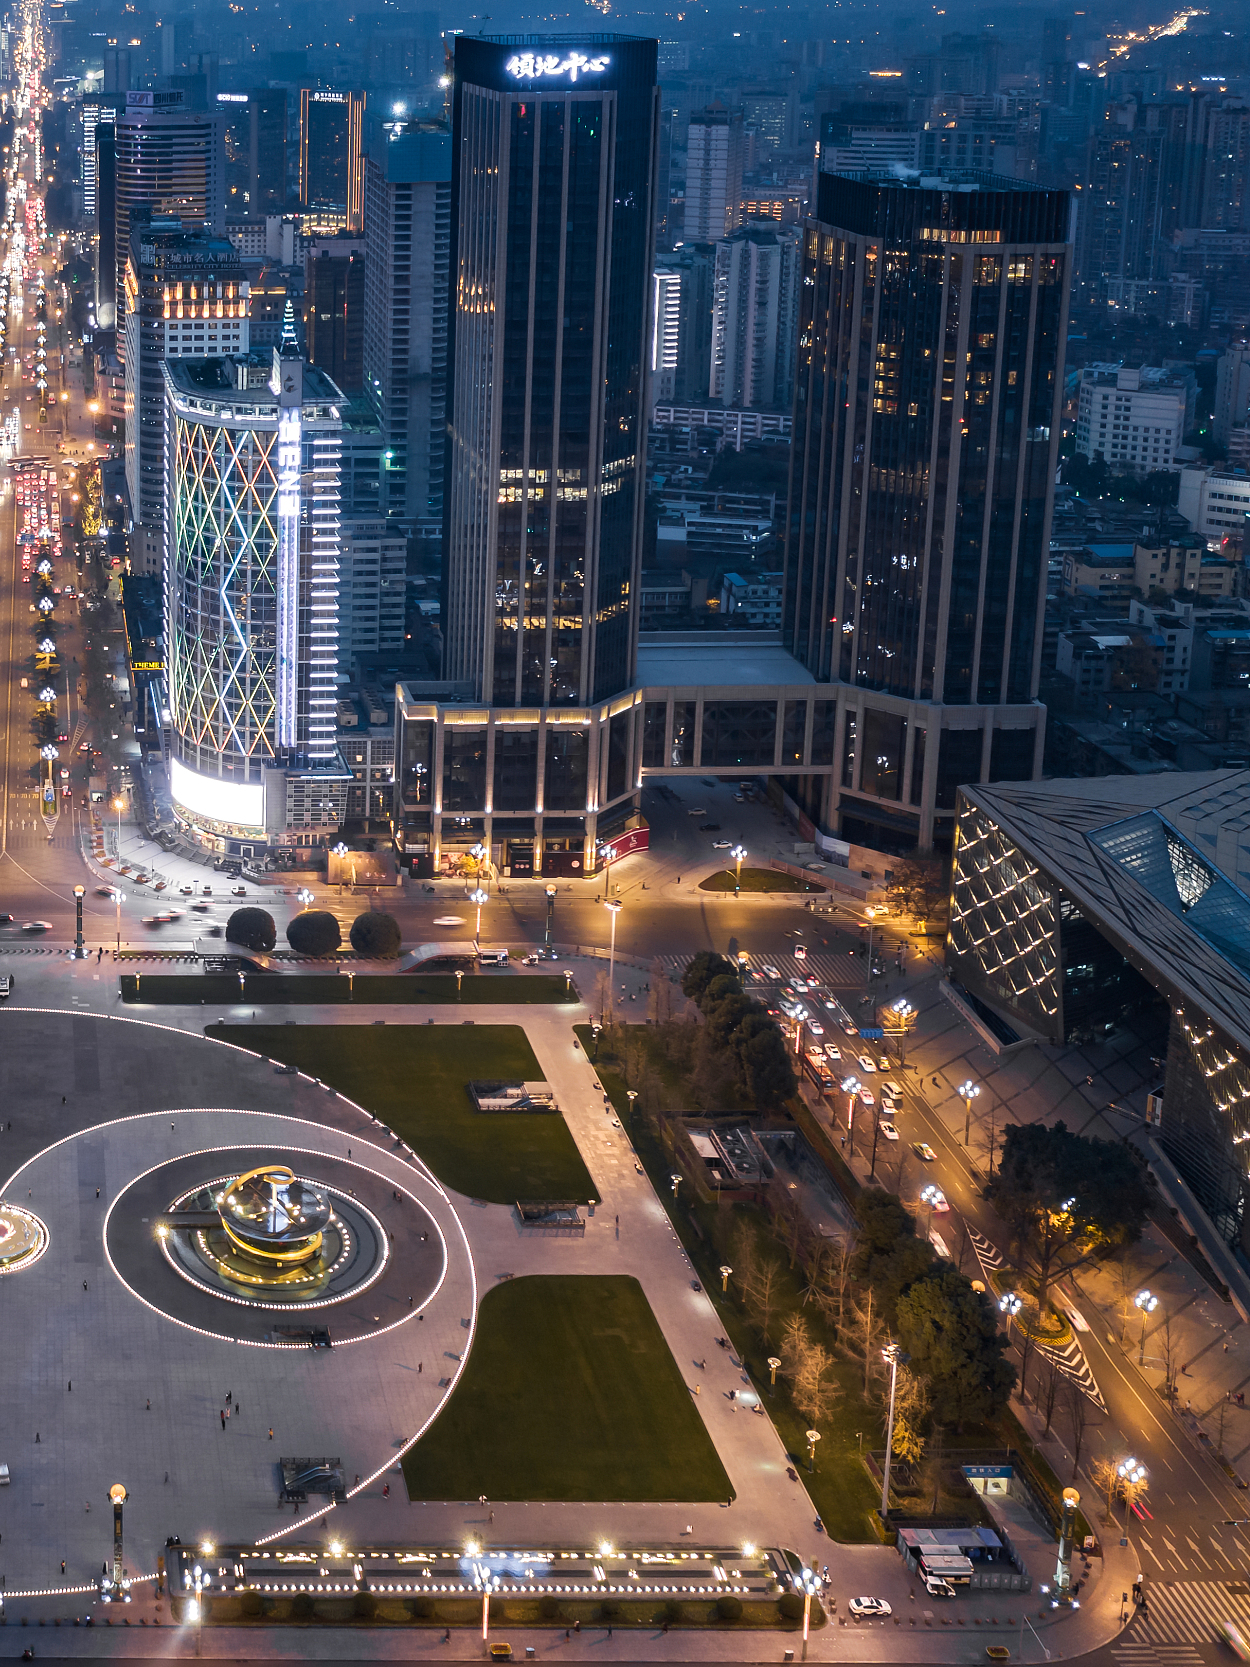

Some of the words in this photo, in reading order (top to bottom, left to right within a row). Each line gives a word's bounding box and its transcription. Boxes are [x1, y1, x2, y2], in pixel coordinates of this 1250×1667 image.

[170, 252, 240, 264] 城市名人酒店
